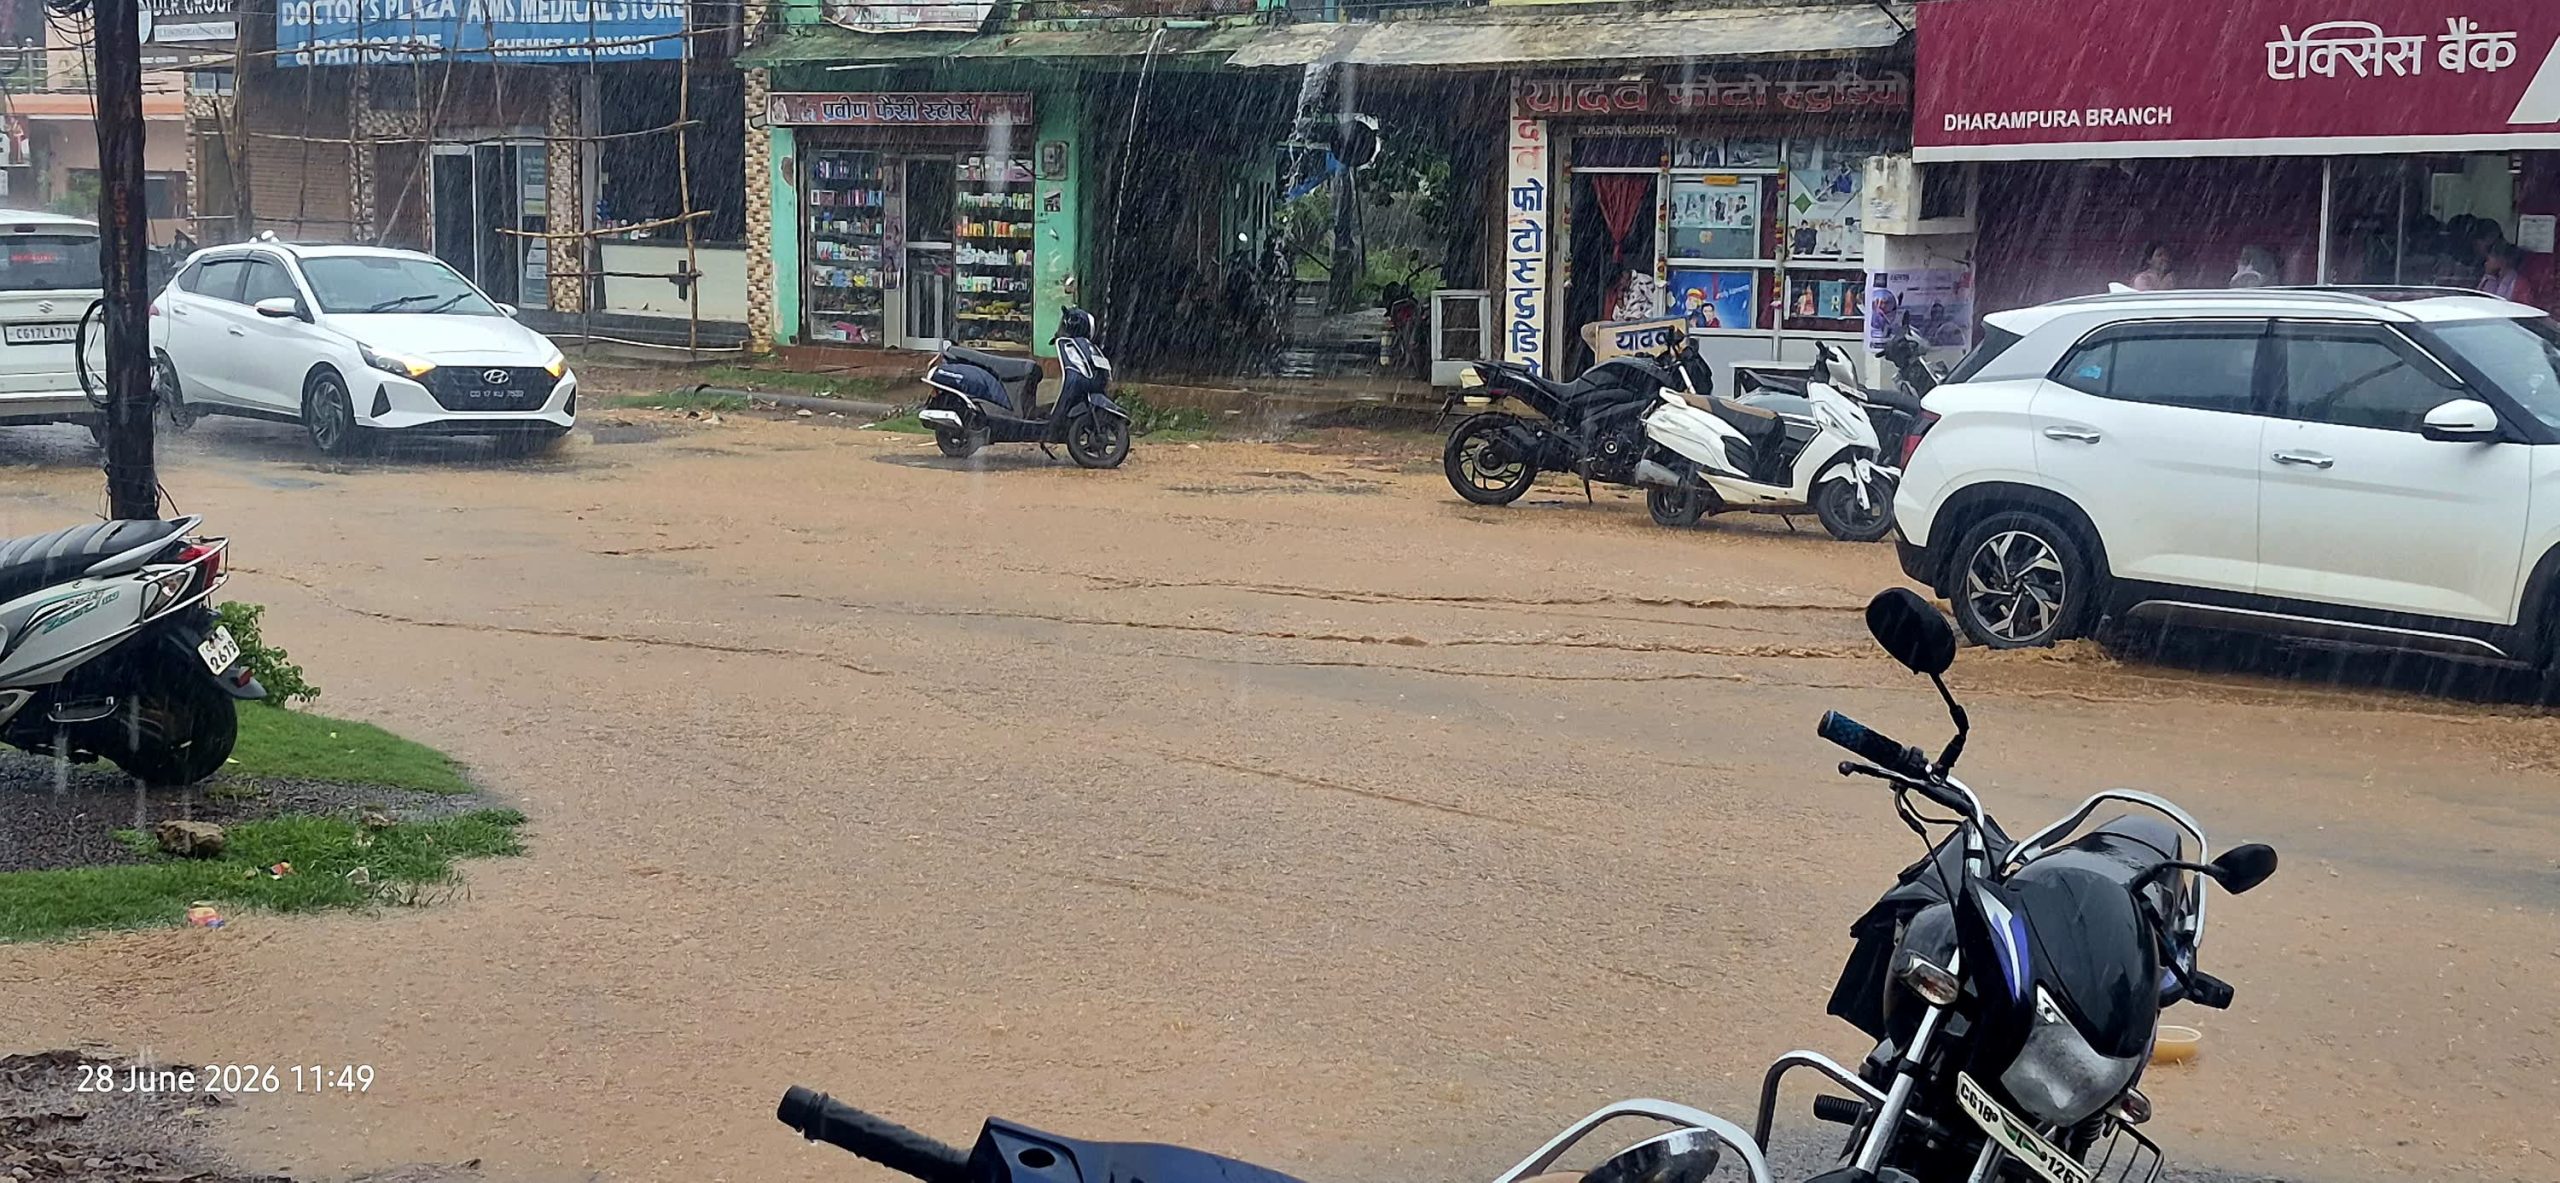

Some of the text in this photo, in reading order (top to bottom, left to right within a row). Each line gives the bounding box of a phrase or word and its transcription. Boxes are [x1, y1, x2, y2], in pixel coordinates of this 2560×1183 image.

[184, 0, 235, 14] GROUP
[282, 0, 457, 26] DOCTOR'S PLAZA
[520, 0, 613, 23] MEDICAL
[494, 38, 564, 57] CHEMIST
[567, 38, 581, 57] &
[2265, 17, 2517, 80] ऐक्सिस बैंक
[1524, 79, 1653, 113] यादव
[1664, 73, 1771, 107] फोटो
[1944, 106, 2172, 131] DHARAMPURA BRANCH
